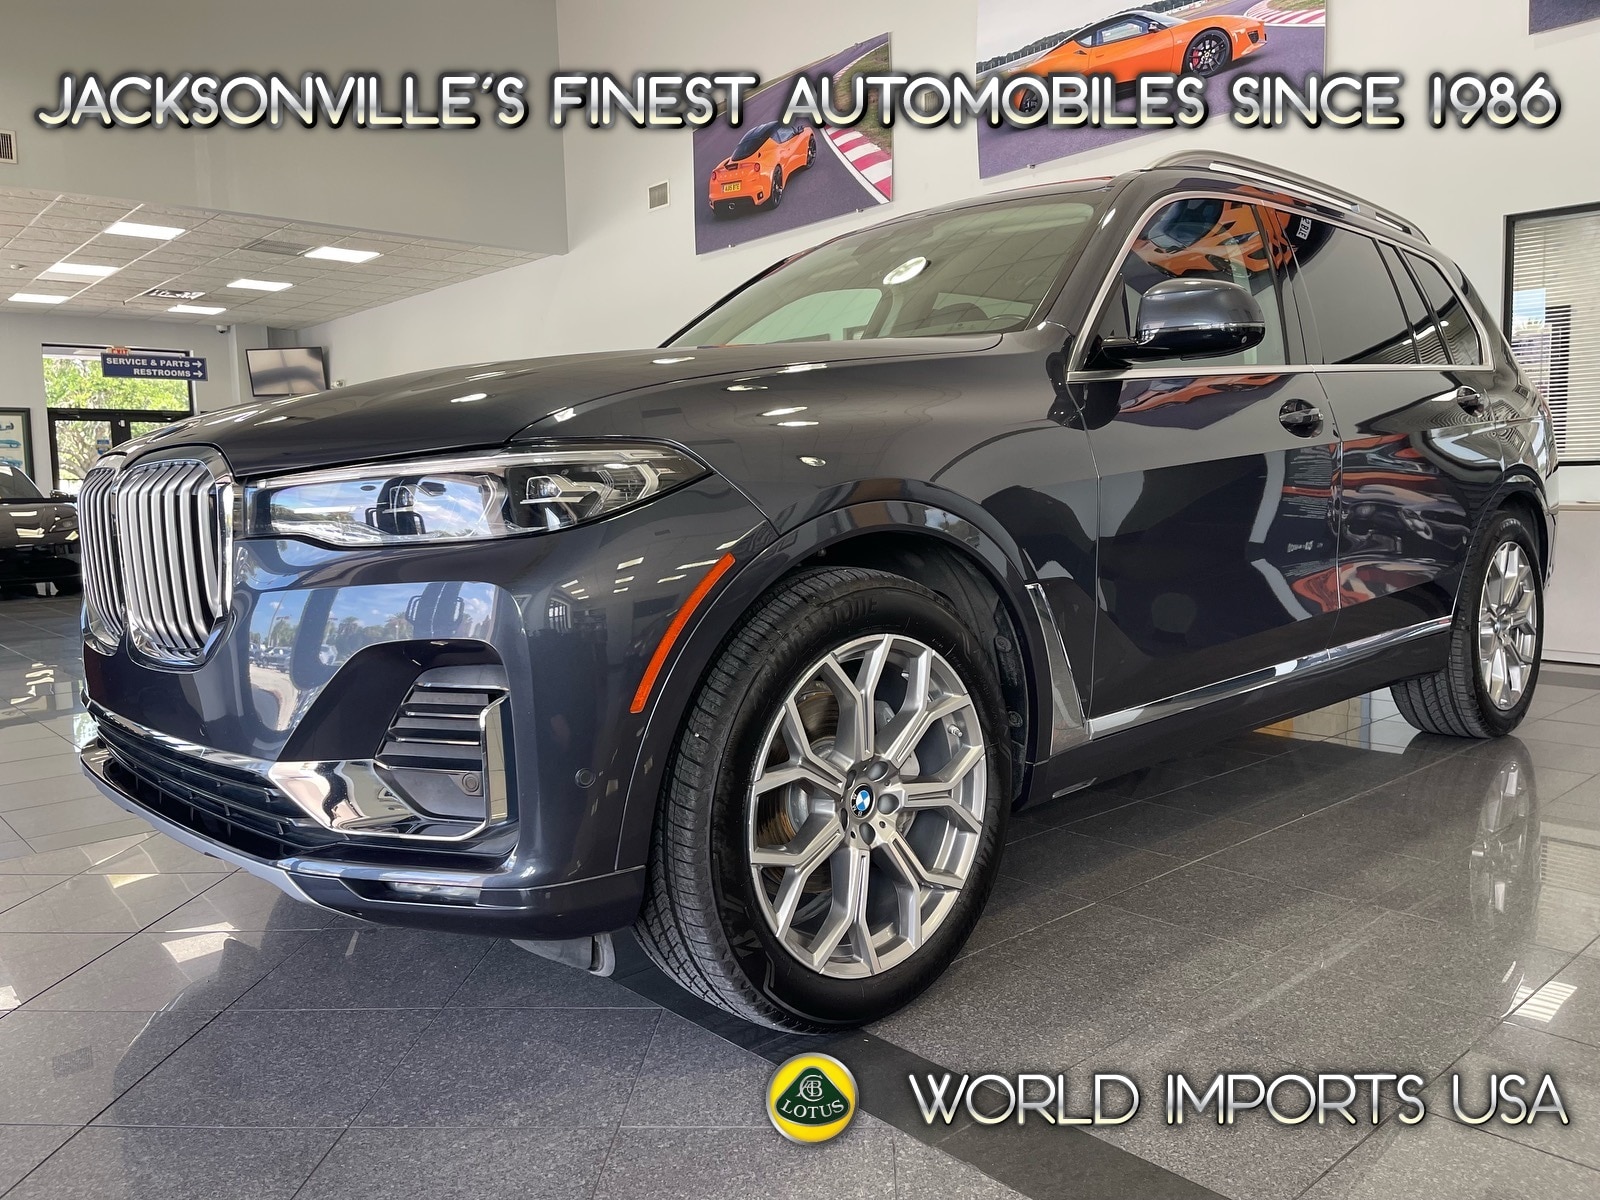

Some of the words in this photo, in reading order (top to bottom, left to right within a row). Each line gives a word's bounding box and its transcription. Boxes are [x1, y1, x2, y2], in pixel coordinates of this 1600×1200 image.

[106, 357, 148, 366] SERVICE
[160, 360, 190, 368] PARTS
[133, 368, 191, 377] RESTROOMS
